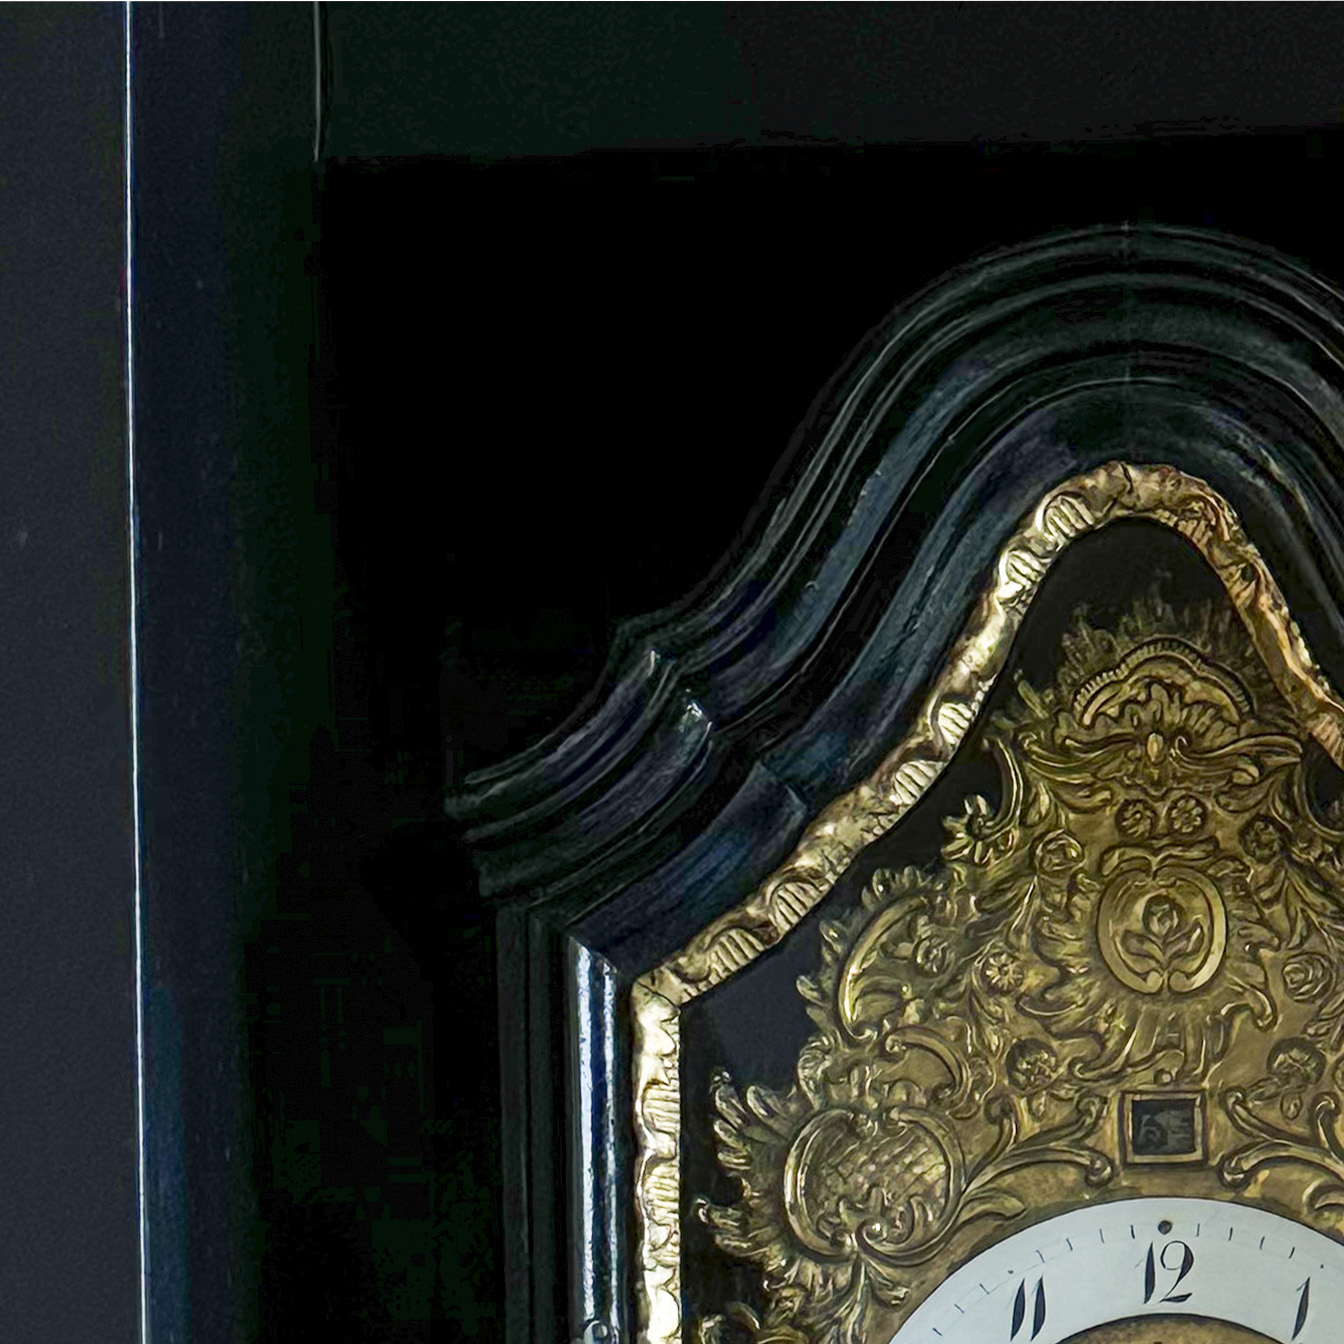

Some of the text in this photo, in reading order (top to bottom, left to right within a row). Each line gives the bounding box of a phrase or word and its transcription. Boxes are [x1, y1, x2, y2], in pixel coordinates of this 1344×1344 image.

[1143, 1240, 1194, 1304] 12
[1010, 1276, 1047, 1341] 11
[1291, 1276, 1312, 1341] 1
